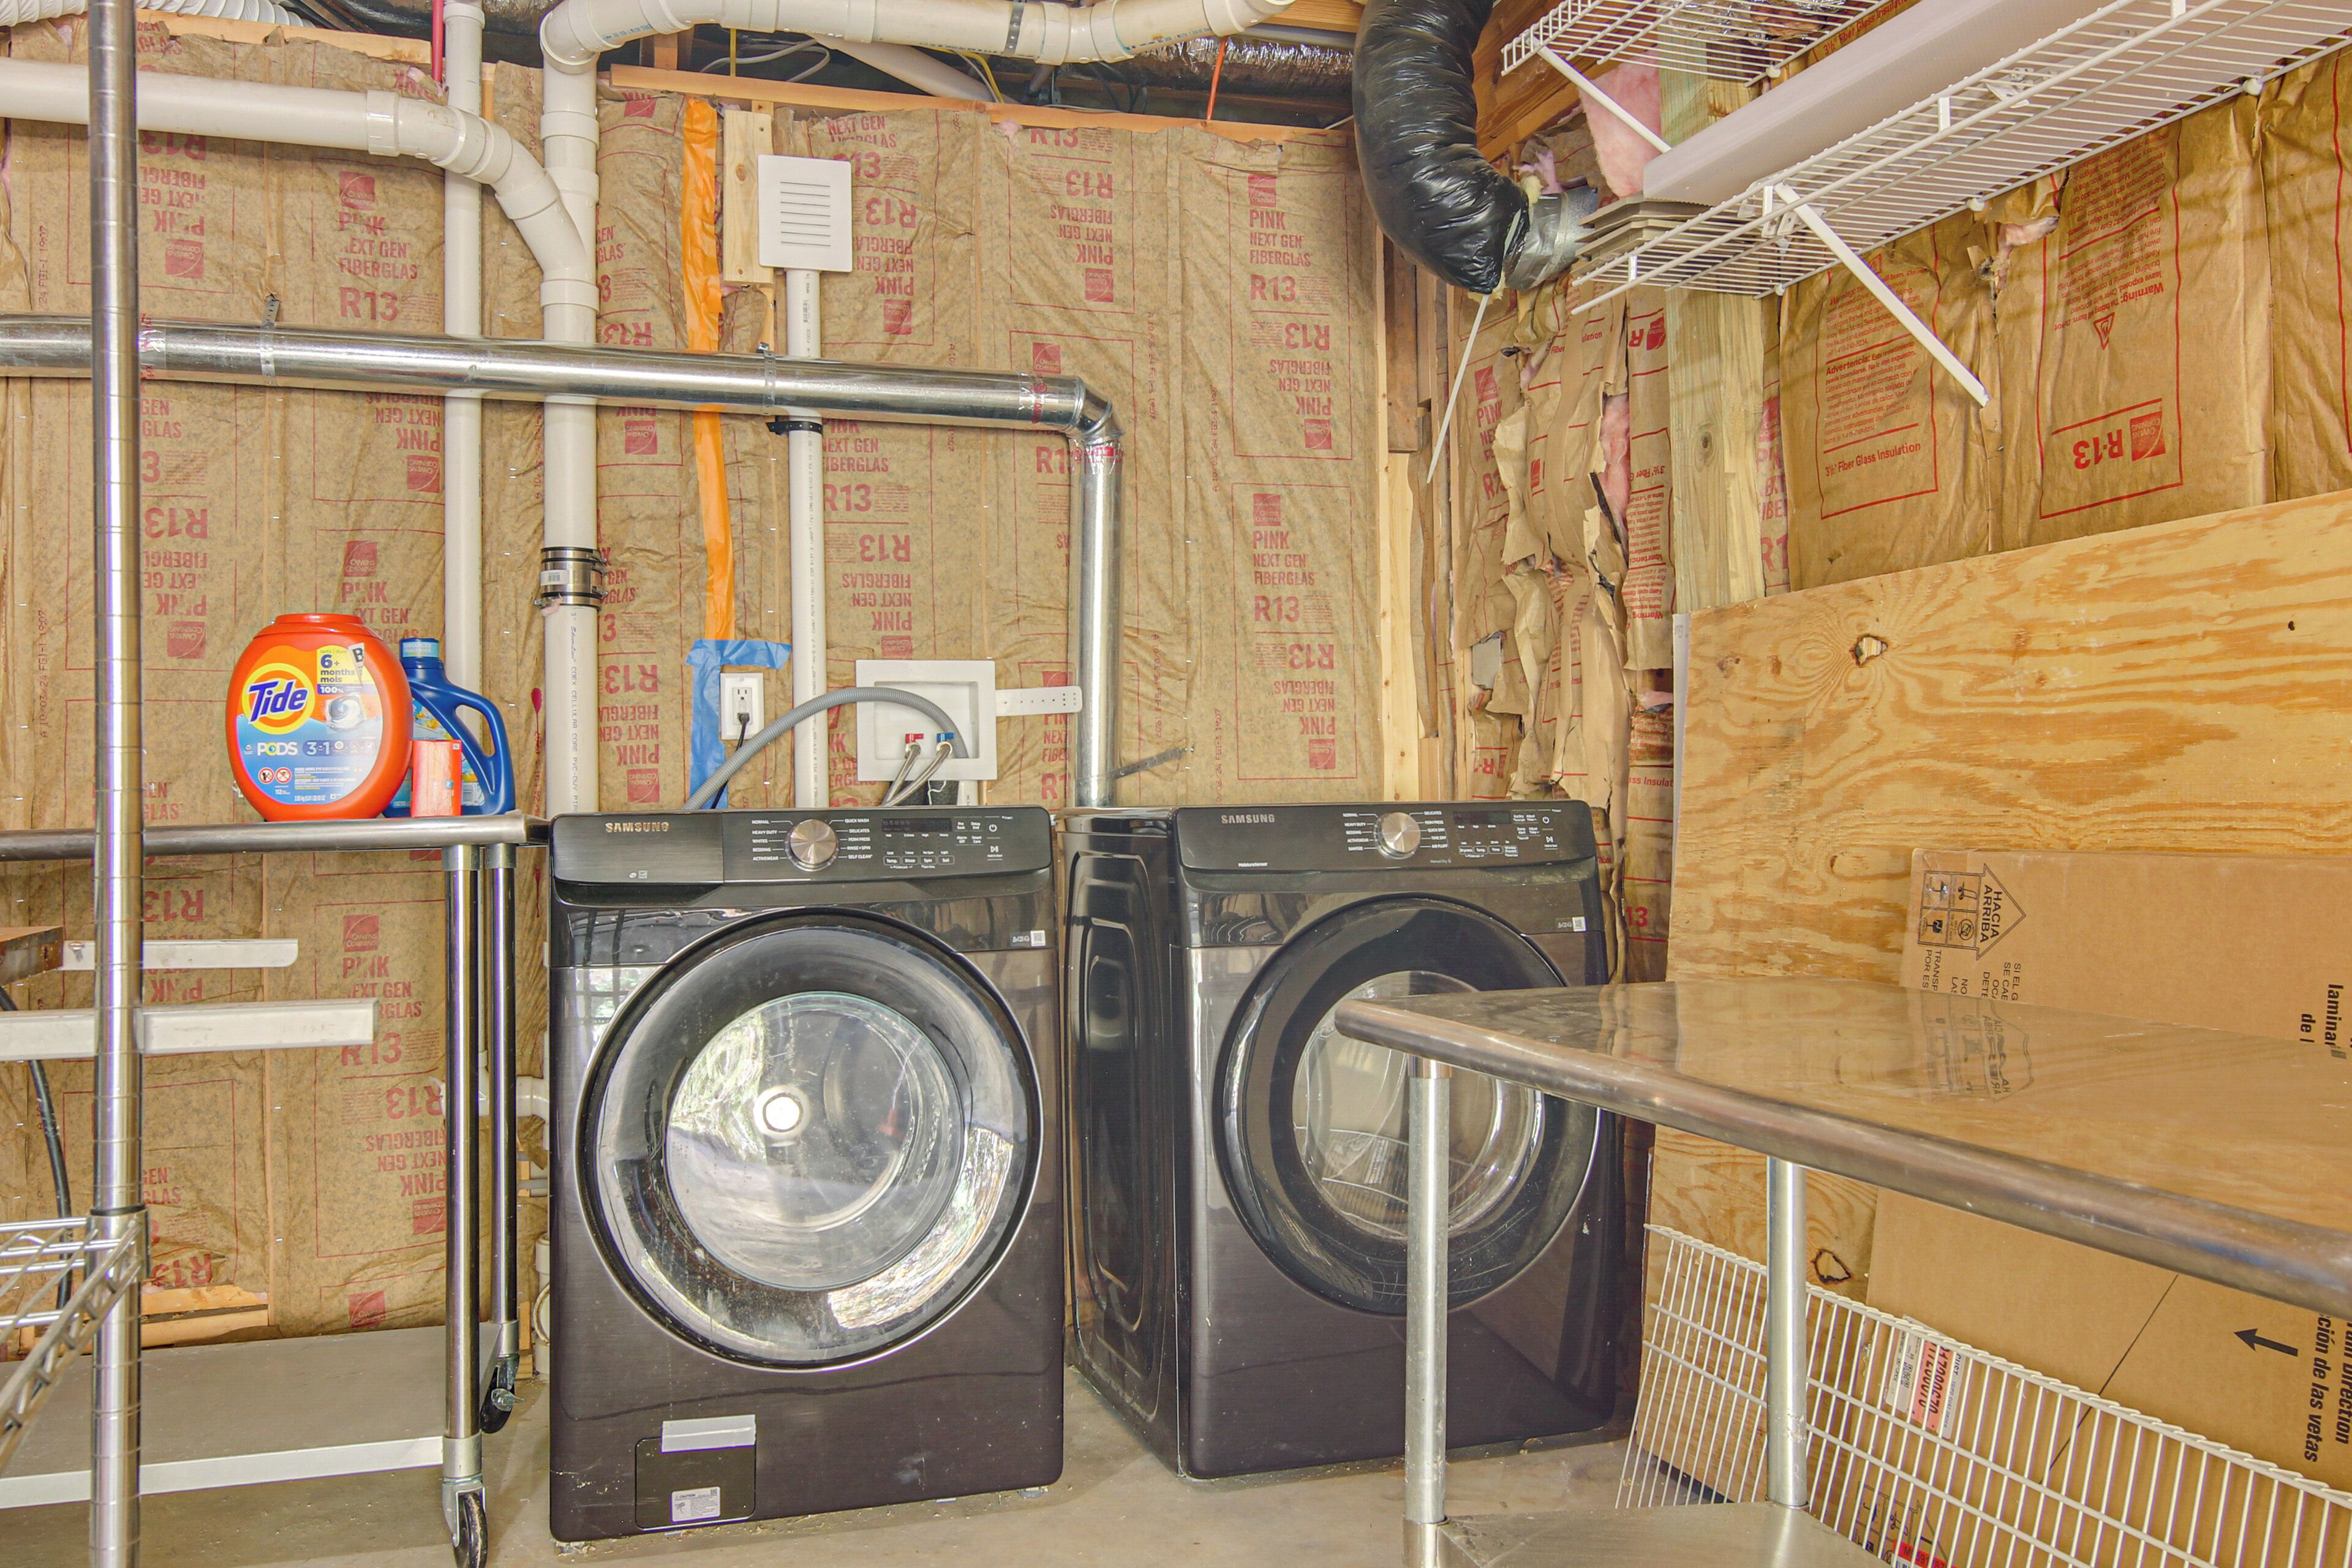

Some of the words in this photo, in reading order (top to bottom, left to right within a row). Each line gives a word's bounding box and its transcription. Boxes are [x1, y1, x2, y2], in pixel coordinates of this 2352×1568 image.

[1839, 28, 1855, 45] Fiber
[1856, 15, 1876, 32] Glass
[827, 118, 857, 136] NEXT
[860, 115, 886, 131] GEN
[1031, 129, 1079, 148] R13
[1065, 170, 1114, 199] R13
[865, 197, 917, 228] R13
[1050, 205, 1113, 225] FIBERGLAS
[1250, 209, 1286, 230] PINK
[1058, 225, 1081, 240] GEN
[1085, 228, 1113, 243] NEXT
[1250, 232, 1277, 246] NEXT
[1281, 235, 1303, 248] GEN
[379, 241, 407, 258] GEN
[1076, 244, 1114, 265] PINK
[1250, 249, 1311, 267] FIBERGLAS
[2144, 249, 2160, 258] Keep
[339, 257, 418, 279] FIBERGLAS
[858, 256, 881, 272] GEN
[884, 257, 914, 273] NEXT
[2135, 260, 2160, 274] building
[875, 276, 914, 297] PINK
[1250, 274, 1296, 302] R13
[2122, 282, 2164, 304] Warning:
[340, 286, 399, 321] R13
[604, 322, 652, 347] R13
[1285, 323, 1330, 351] R13
[1270, 359, 1330, 375] FIBERGLAS
[1826, 355, 1871, 376] Advertencia:
[1894, 363, 1906, 372] para
[1278, 377, 1300, 392] GEN
[1304, 379, 1331, 393] NEXT
[141, 400, 170, 416] GEN
[1295, 396, 1332, 416] PINK
[375, 409, 402, 424] GEN
[407, 410, 440, 427] NEXT
[2132, 418, 2160, 429] CORNING
[141, 420, 183, 439] GLAS
[2132, 427, 2156, 439] OWENS
[396, 429, 440, 452] PINK
[854, 439, 879, 453] GEN
[2073, 429, 2124, 470] R-13
[1838, 457, 1854, 472] Fiber
[1856, 451, 1876, 466] Glass
[1877, 442, 1921, 461] Insulation
[141, 451, 161, 483] 3
[1636, 468, 1651, 478] Fiber
[823, 484, 872, 512] R13
[145, 508, 208, 539] R13
[859, 535, 911, 563] R13
[1253, 530, 1290, 550] PINK
[1253, 553, 1281, 568] NEXT
[1284, 554, 1306, 568] GEN
[608, 569, 628, 585] GEN
[842, 573, 911, 589] FIBERGLAS
[1254, 570, 1315, 586] FIBERGLAS
[851, 592, 876, 607] GEN
[881, 592, 912, 607] NEXT
[1254, 595, 1300, 622] R13
[38, 609, 47, 636] 19:07
[381, 608, 409, 624] GEN
[872, 611, 913, 631] PINK
[1288, 643, 1335, 669] R13
[605, 665, 659, 693] R13
[1273, 680, 1335, 695] FIBERGLAS
[248, 680, 308, 723] Tide
[1283, 698, 1305, 712] GEN
[1308, 698, 1335, 712] NEXT
[600, 725, 627, 742] GEN
[632, 725, 660, 741] NEXT
[1299, 716, 1336, 736] PINK
[257, 742, 298, 756] PODS
[617, 744, 660, 766] PINK
[605, 821, 669, 833] SAMSUNG
[1221, 814, 1275, 824] SAMSUNG
[144, 890, 204, 922] R13
[1980, 884, 1992, 943] ARRIBA
[1990, 891, 2003, 938] HACIA
[1923, 949, 1932, 971] POR
[2003, 962, 2011, 976] SE
[2014, 963, 2021, 974] SI
[1931, 949, 1942, 992] TRANSP
[383, 981, 412, 998] GEN
[1922, 974, 1930, 989] ES
[1959, 979, 1968, 995] NO
[1981, 971, 1990, 998] DETE
[2001, 980, 2010, 1000] CAE
[2012, 976, 2021, 989] EL
[2011, 993, 2019, 1001] G
[2300, 1013, 2316, 1033] de
[377, 1153, 406, 1172] GEN
[412, 1148, 447, 1169] NEXT
[401, 1172, 447, 1197] PINK
[2313, 1357, 2332, 1379] de
[2310, 1382, 2330, 1410] las
[2304, 1414, 2323, 1463] vetas
